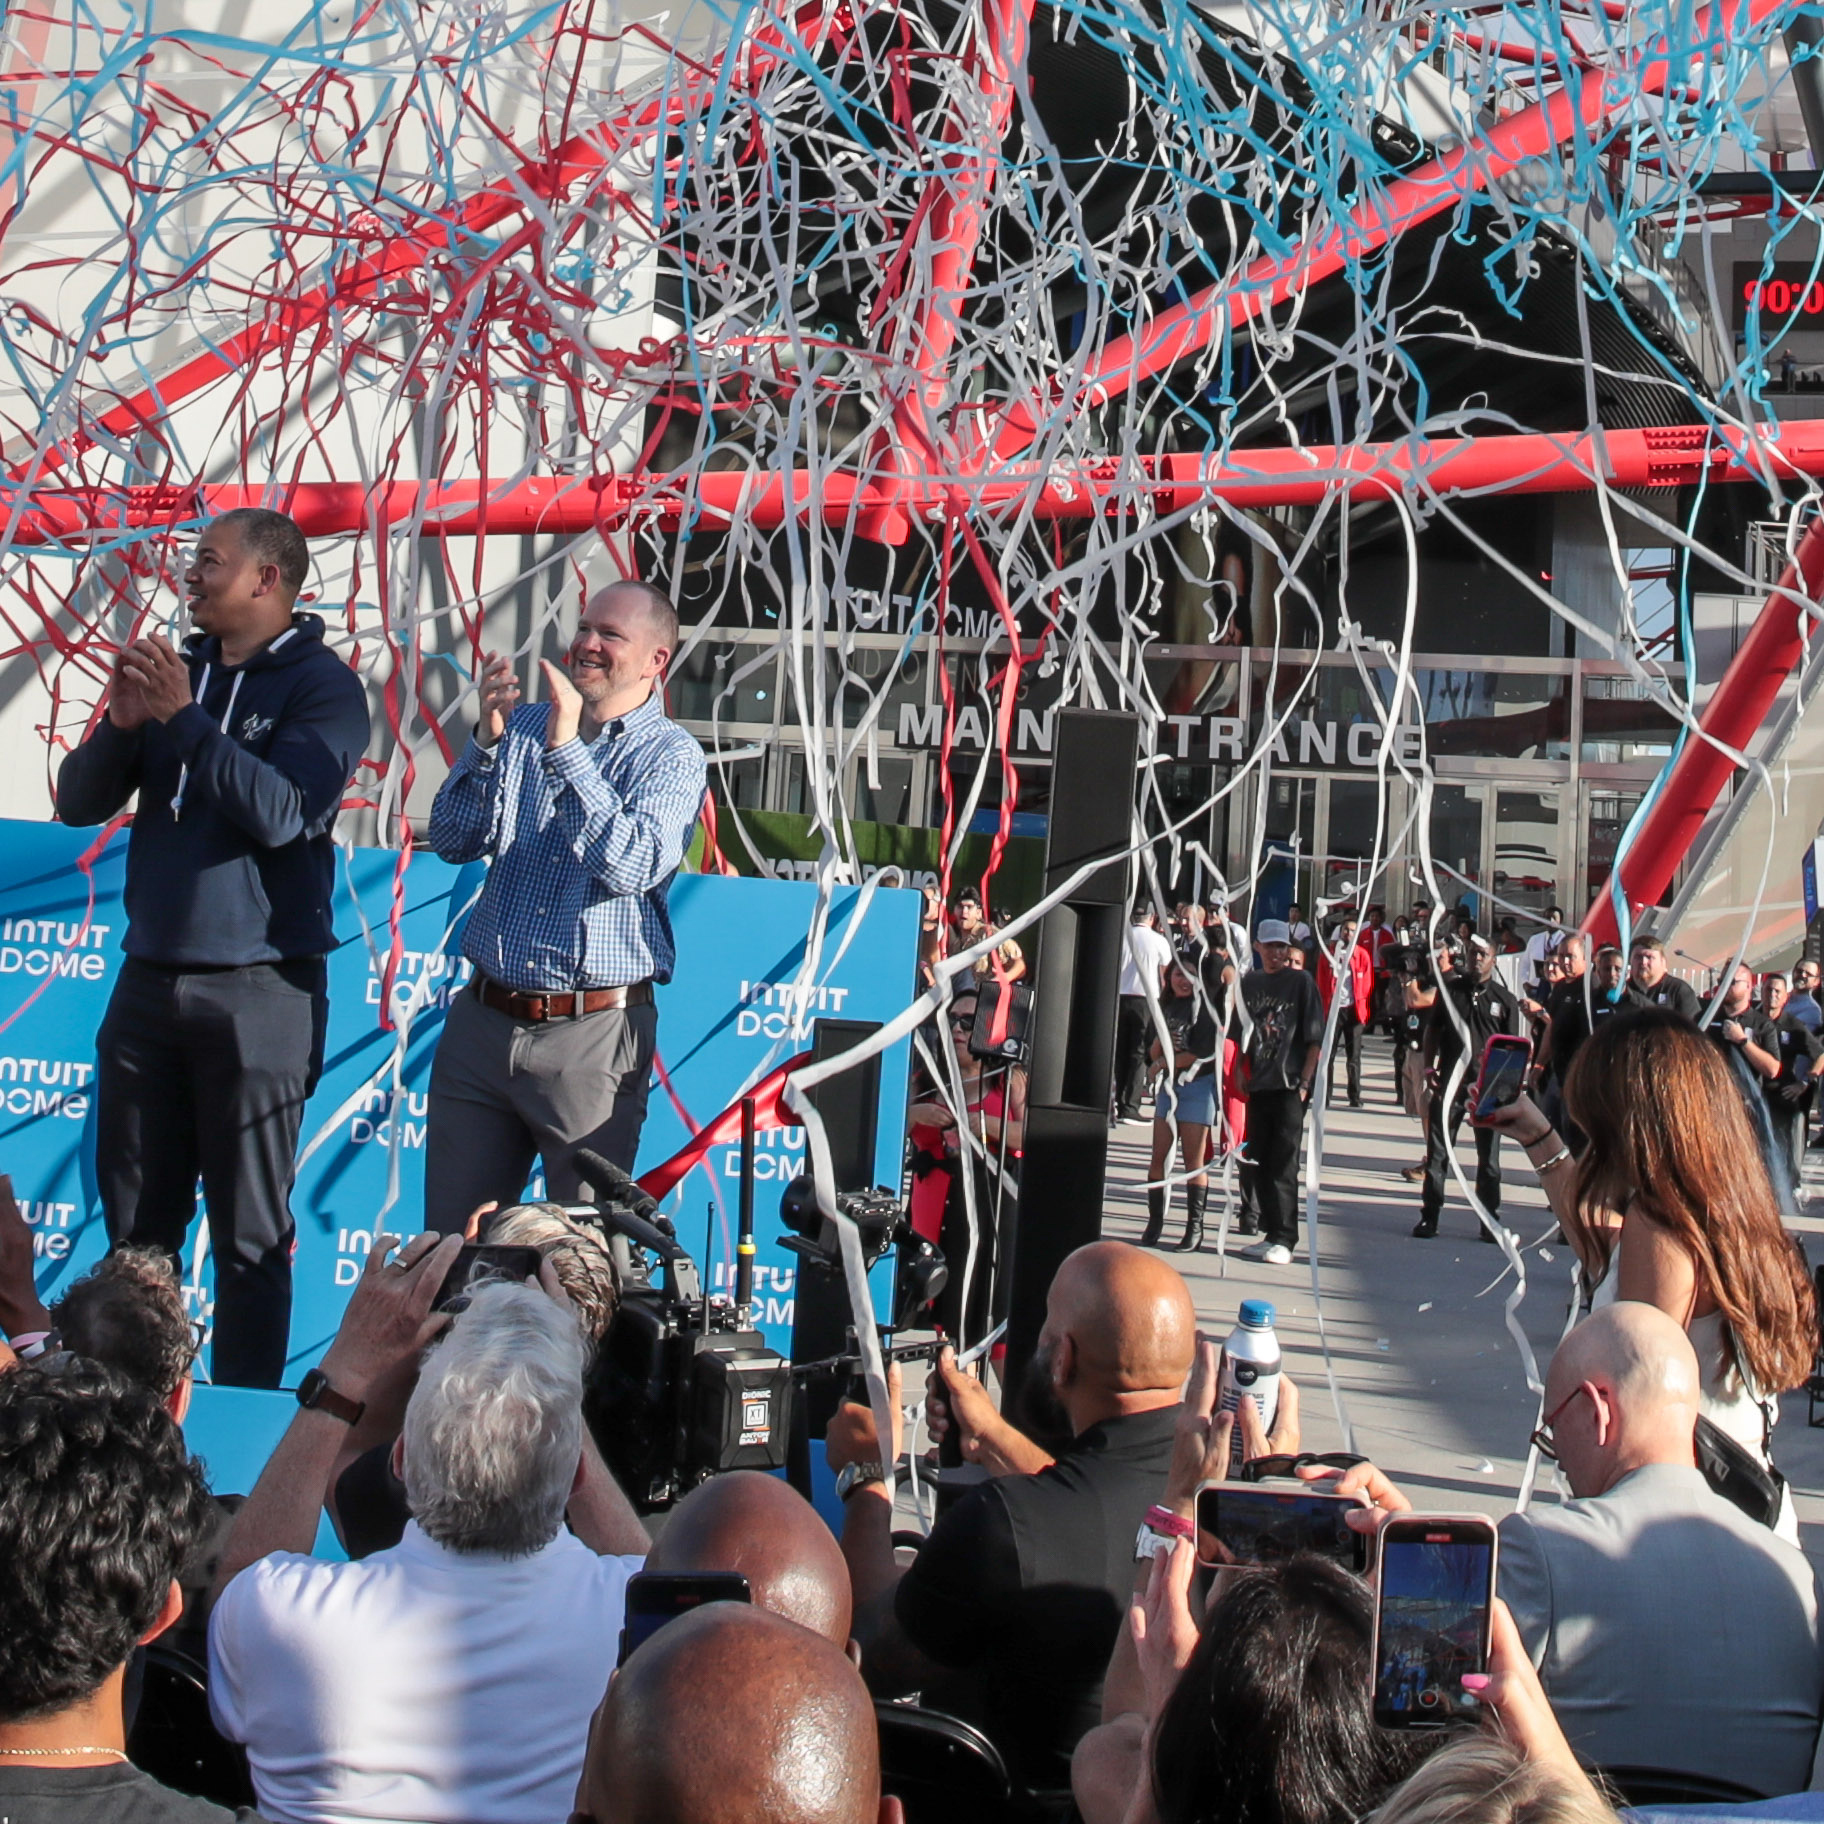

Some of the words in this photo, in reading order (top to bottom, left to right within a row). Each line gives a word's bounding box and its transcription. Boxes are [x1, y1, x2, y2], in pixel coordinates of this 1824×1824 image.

[898, 702, 1054, 753] MAN
[1140, 714, 1426, 767] TRANCE
[737, 1010, 816, 1041] DOM
[351, 1117, 427, 1149] DOM
